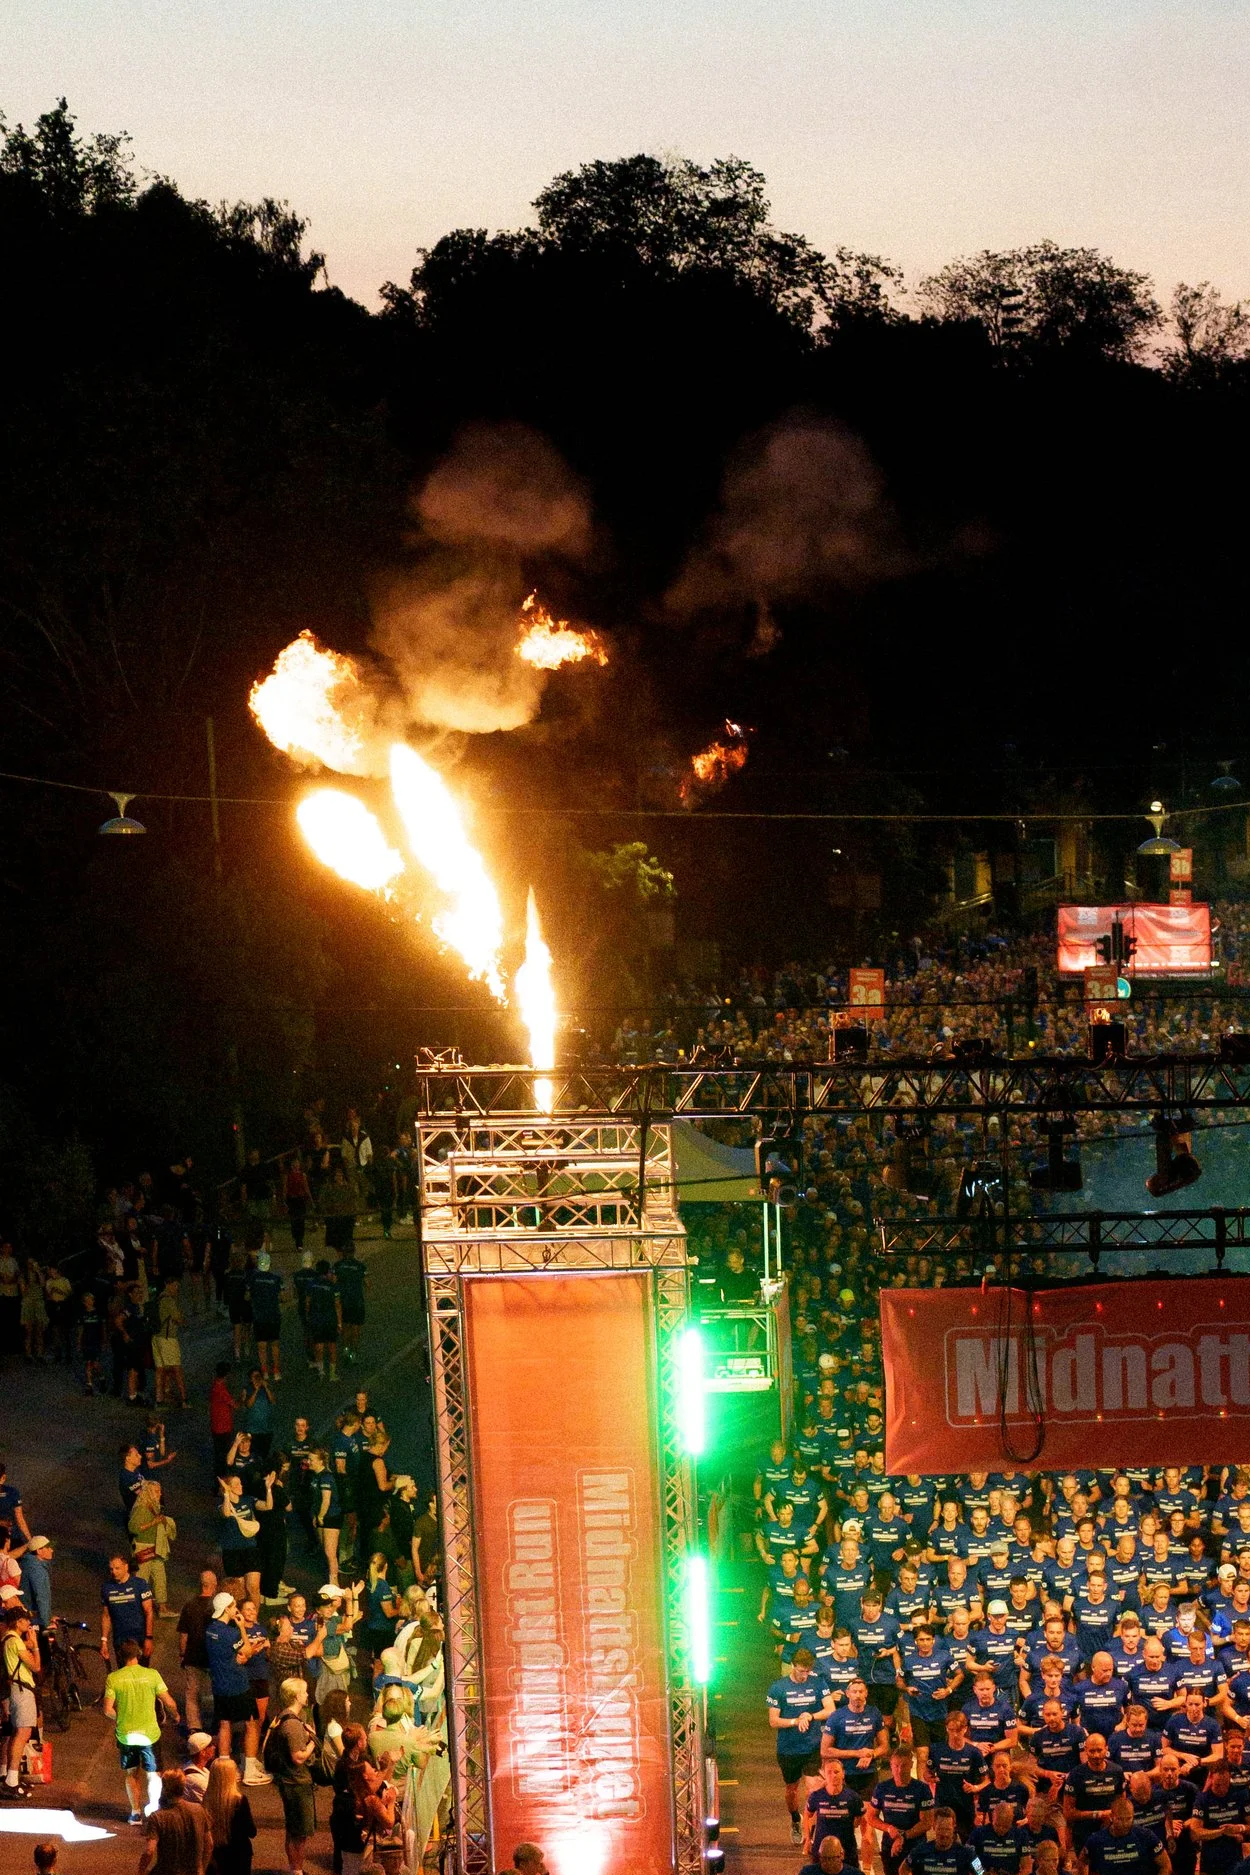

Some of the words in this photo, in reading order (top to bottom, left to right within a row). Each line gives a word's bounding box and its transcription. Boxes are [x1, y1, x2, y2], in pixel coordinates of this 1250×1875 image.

[509, 1505, 555, 1589] Run
[582, 1473, 640, 1819] Midnattsloppet
[511, 1593, 568, 1795] Midnight
